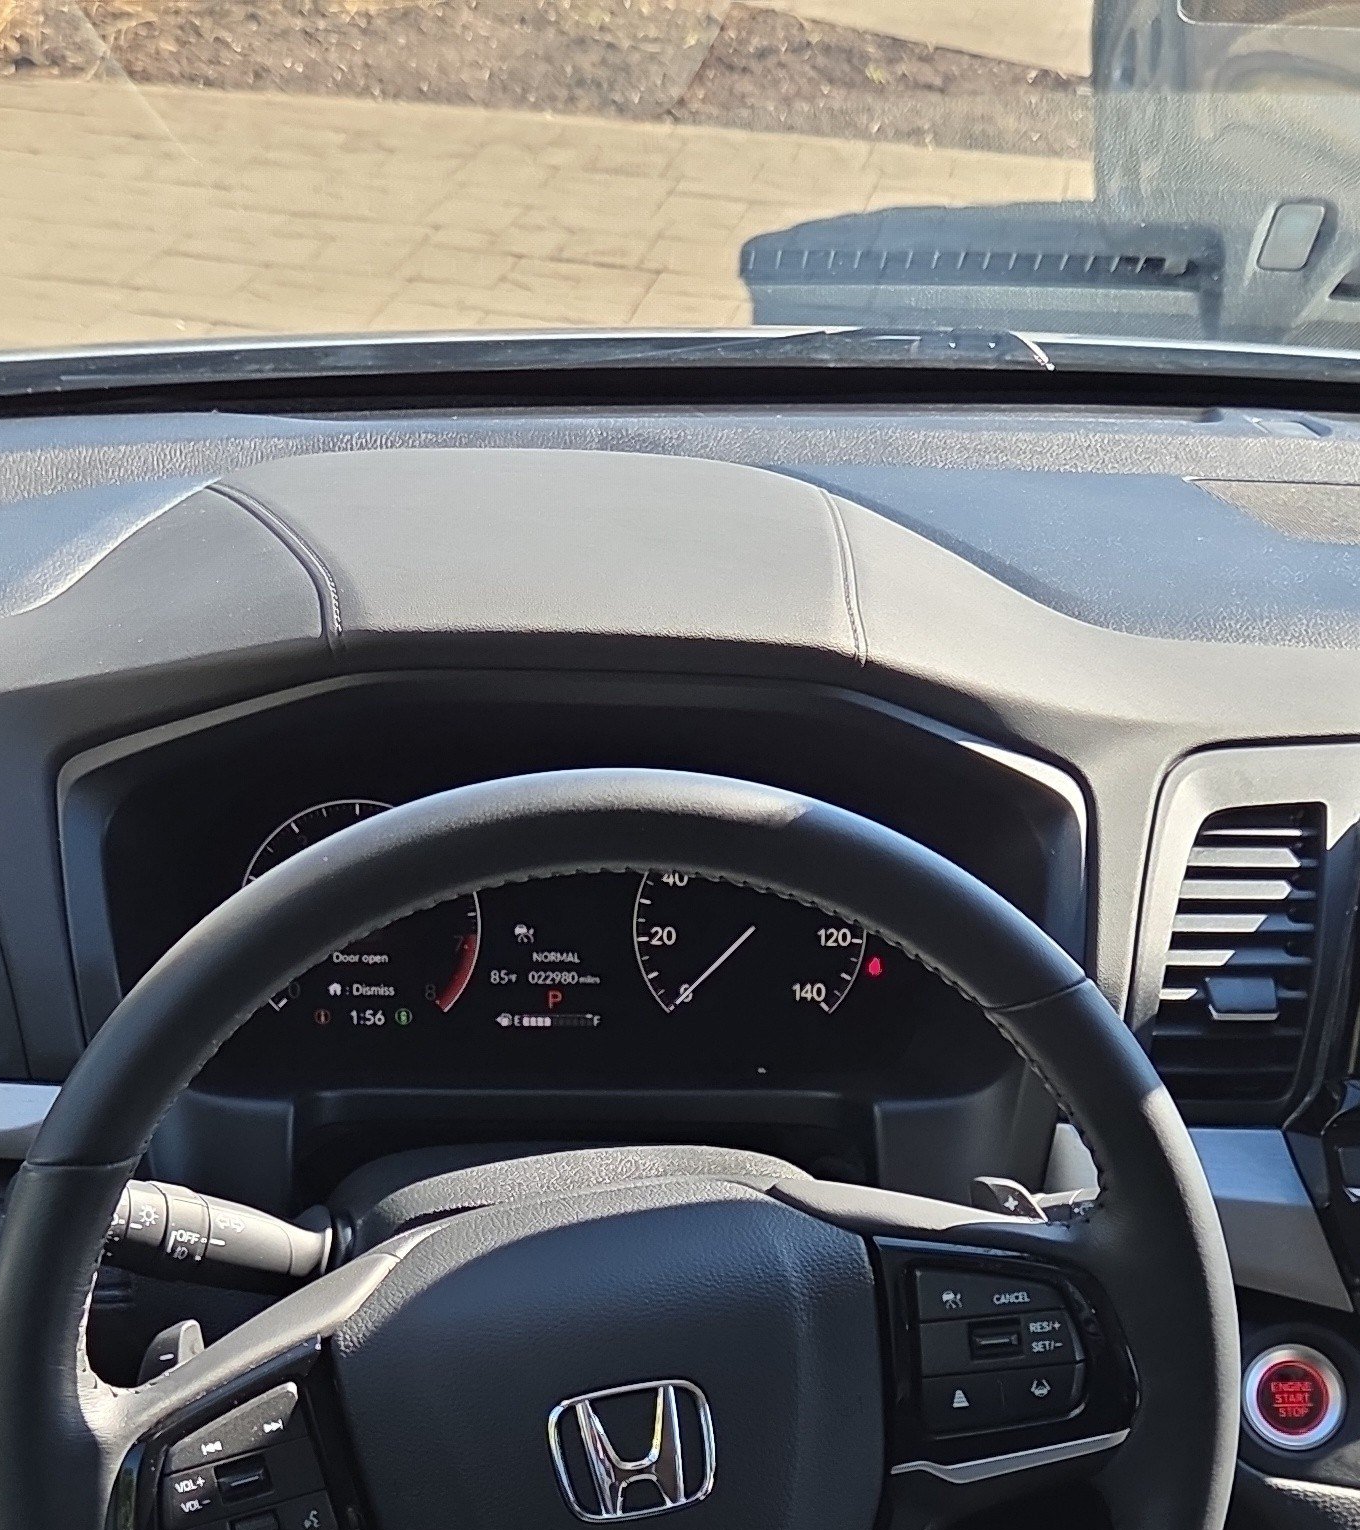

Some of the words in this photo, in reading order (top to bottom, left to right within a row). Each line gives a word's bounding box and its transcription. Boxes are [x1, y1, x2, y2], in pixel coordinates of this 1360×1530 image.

[650, 926, 677, 946] 20
[817, 928, 852, 947] 120
[332, 952, 359, 963] Door
[362, 954, 389, 965] open
[532, 951, 580, 963] NORMAL
[528, 971, 578, 985] 022980
[352, 983, 395, 996] Dismiss
[792, 983, 826, 1002] 140
[548, 990, 563, 1009] P
[350, 1009, 386, 1026] 1:56
[176, 1229, 201, 1244] OFF
[993, 1291, 1031, 1305] CANCEL
[1275, 1393, 1310, 1403] START
[1279, 1406, 1309, 1417] STOP
